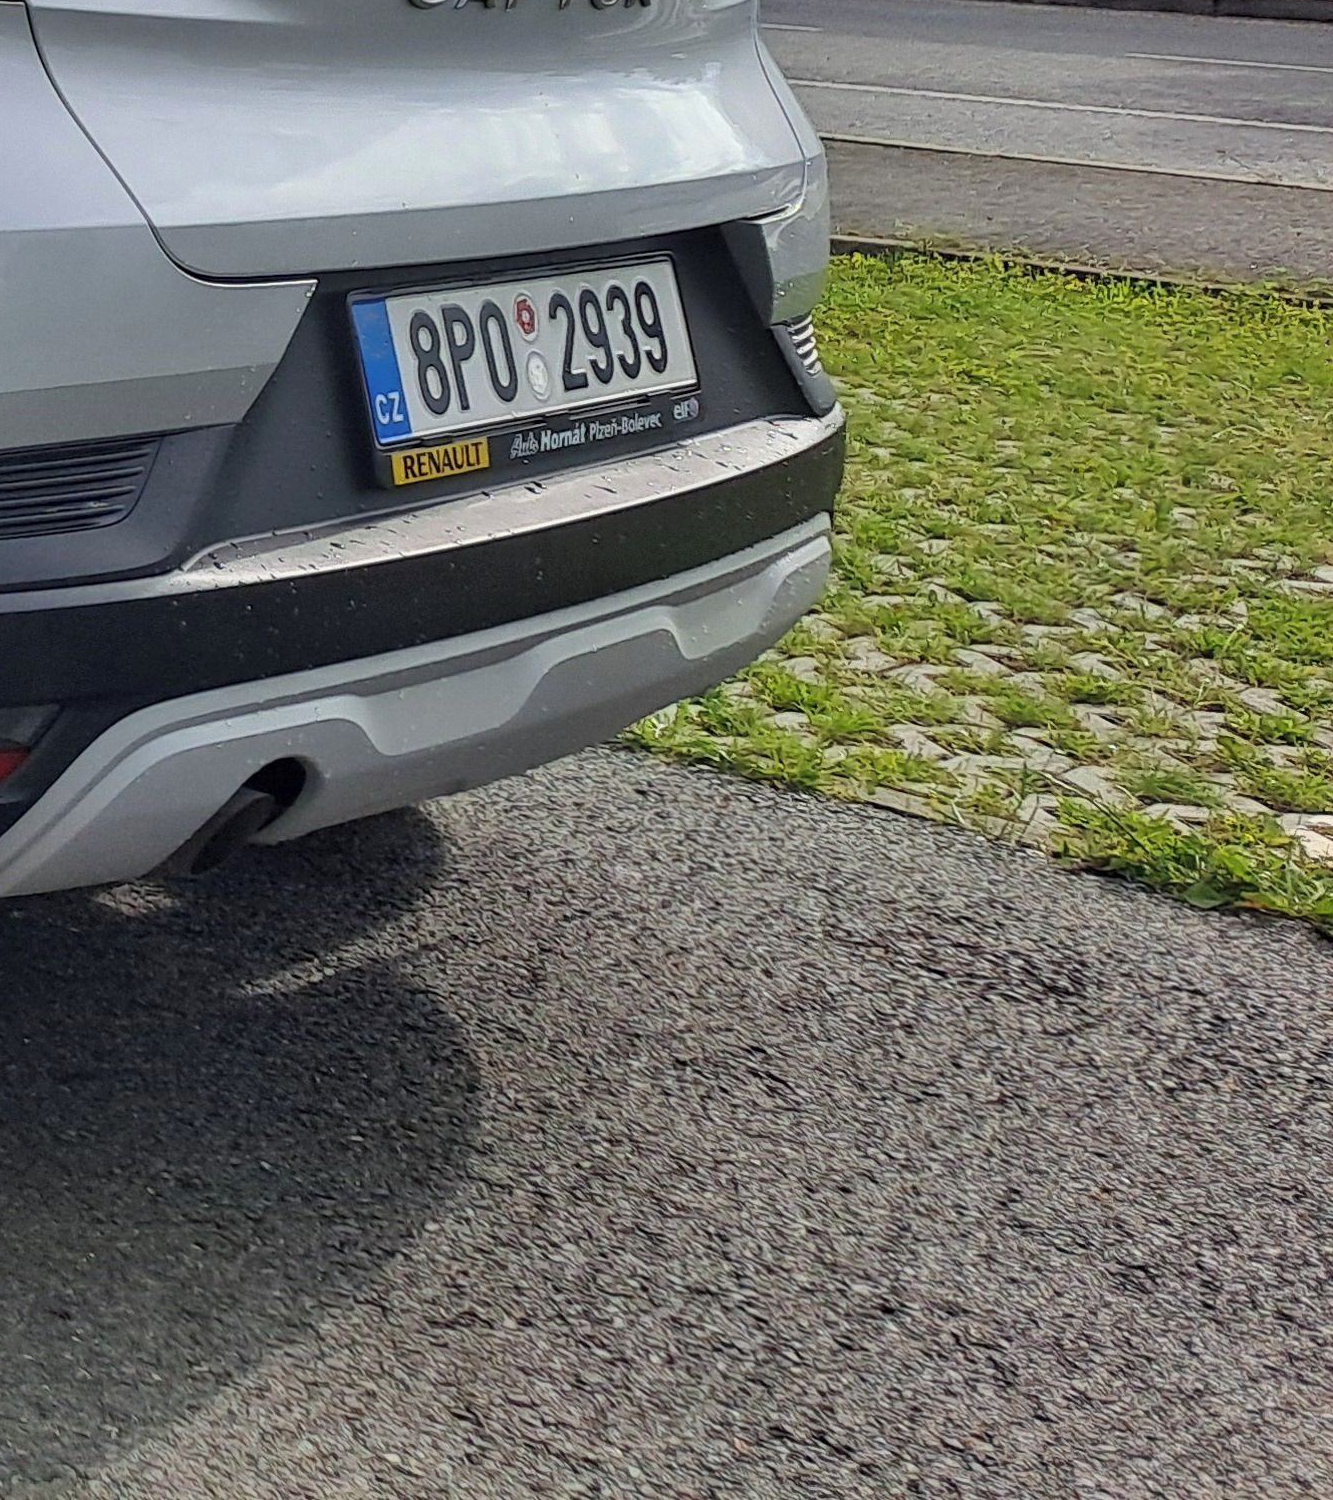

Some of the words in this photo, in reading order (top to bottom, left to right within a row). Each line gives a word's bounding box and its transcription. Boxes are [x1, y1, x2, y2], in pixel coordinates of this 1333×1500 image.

[548, 280, 668, 393] 2939
[374, 391, 404, 426] CZ
[403, 441, 484, 481] RENAULT
